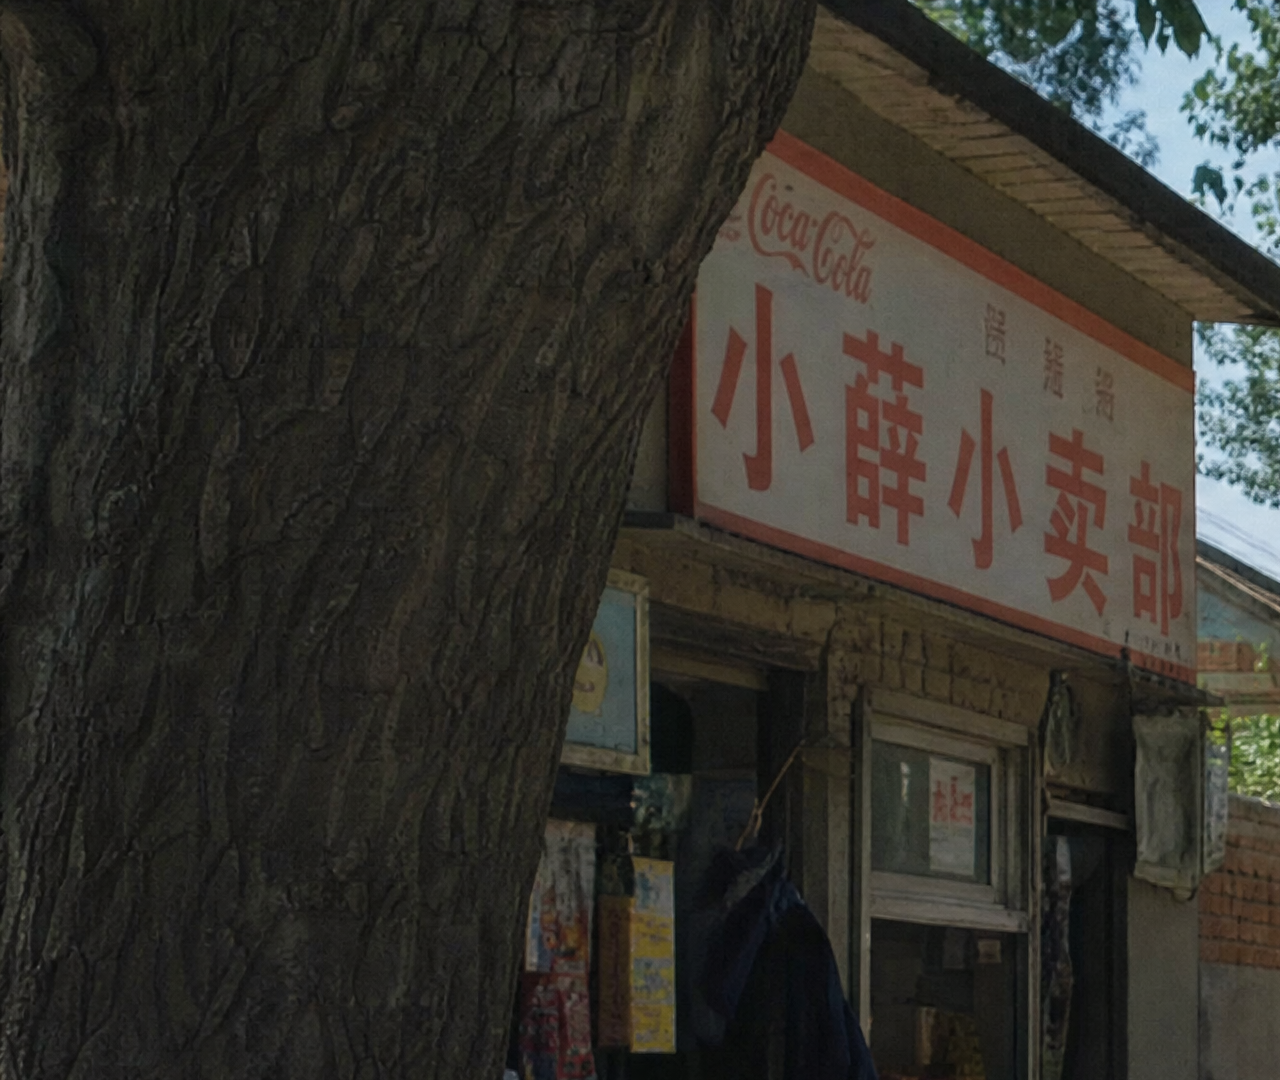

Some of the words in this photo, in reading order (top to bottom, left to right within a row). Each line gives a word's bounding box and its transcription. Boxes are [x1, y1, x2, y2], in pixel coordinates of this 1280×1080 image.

[710, 282, 1183, 636] 小薛小卖部
